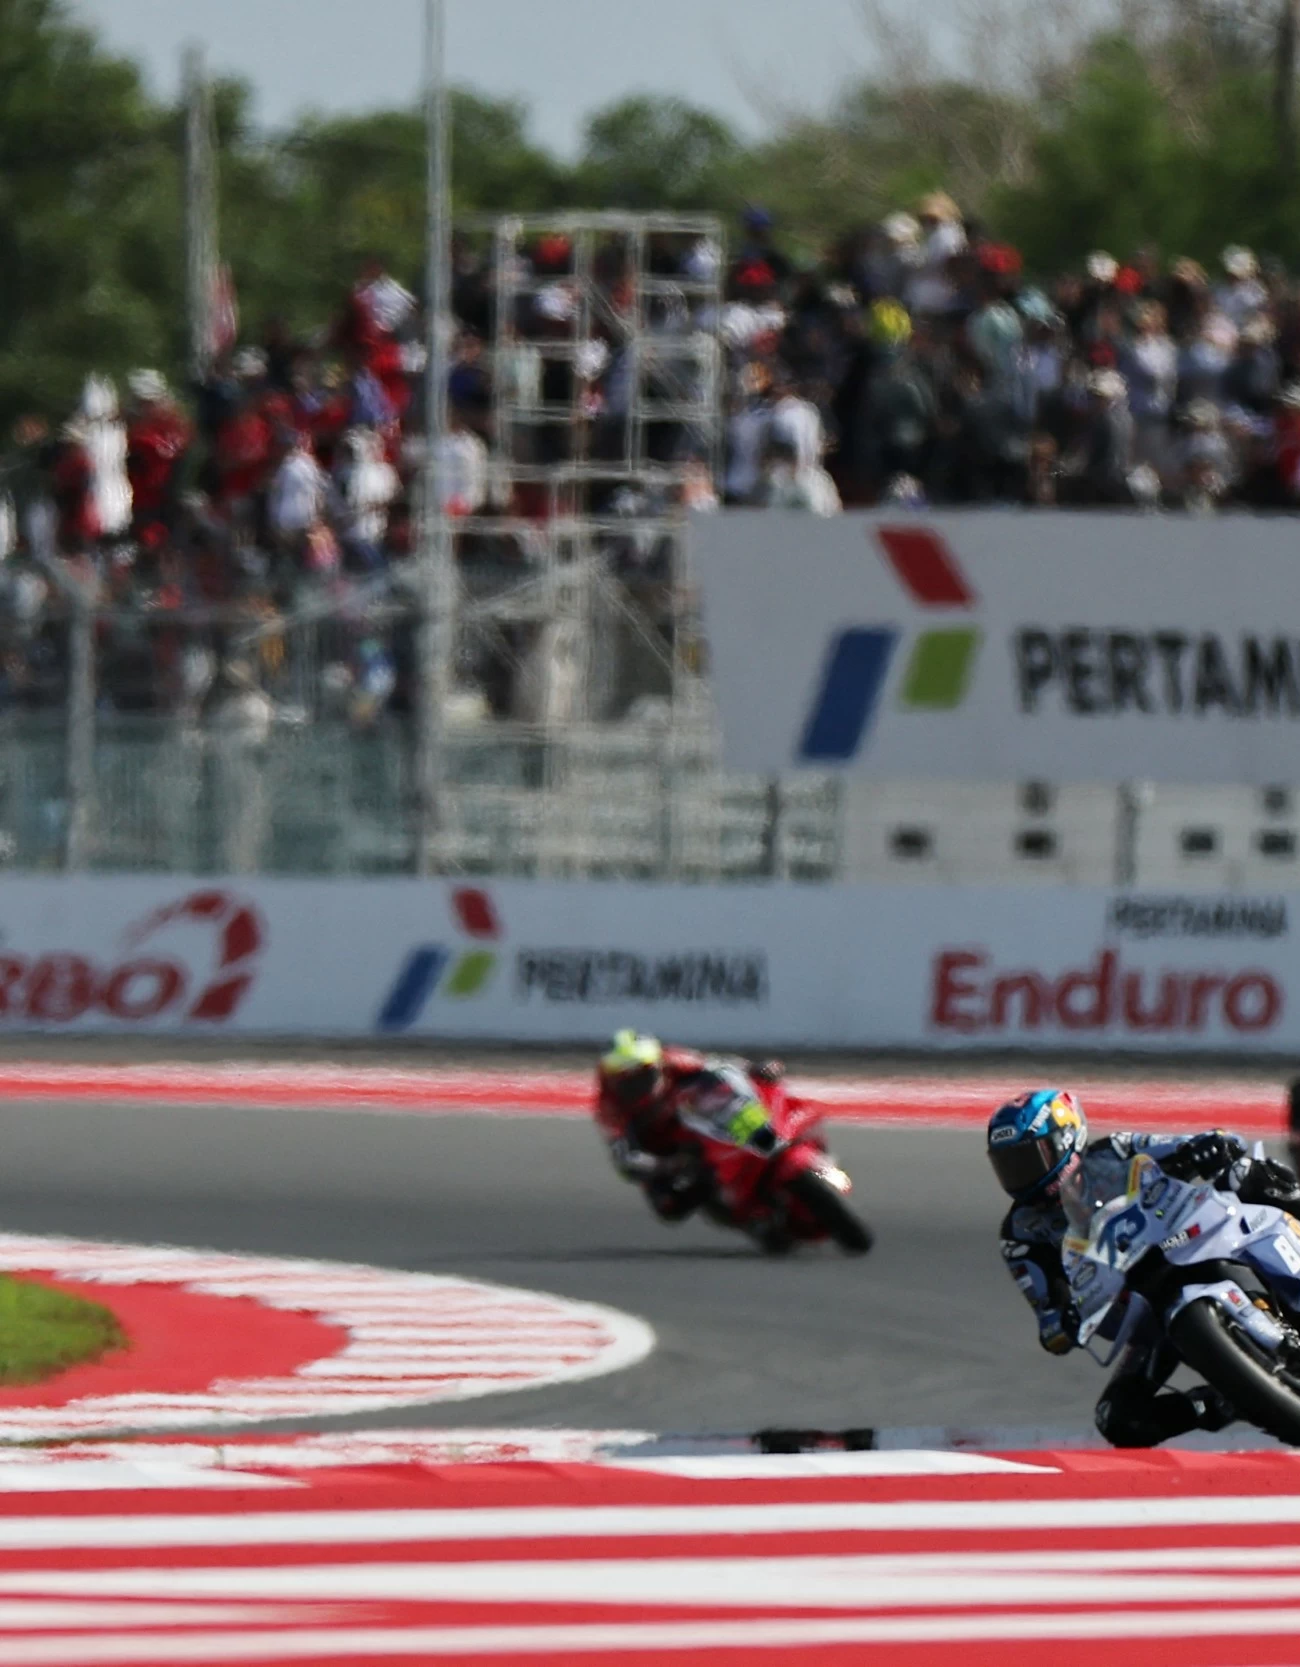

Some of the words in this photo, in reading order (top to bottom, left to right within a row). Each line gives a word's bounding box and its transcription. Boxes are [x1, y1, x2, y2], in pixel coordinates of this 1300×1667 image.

[1107, 897, 1288, 938] PERTAMINA
[517, 948, 767, 1003] PERTAMINA
[928, 948, 1284, 1033] Enduro
